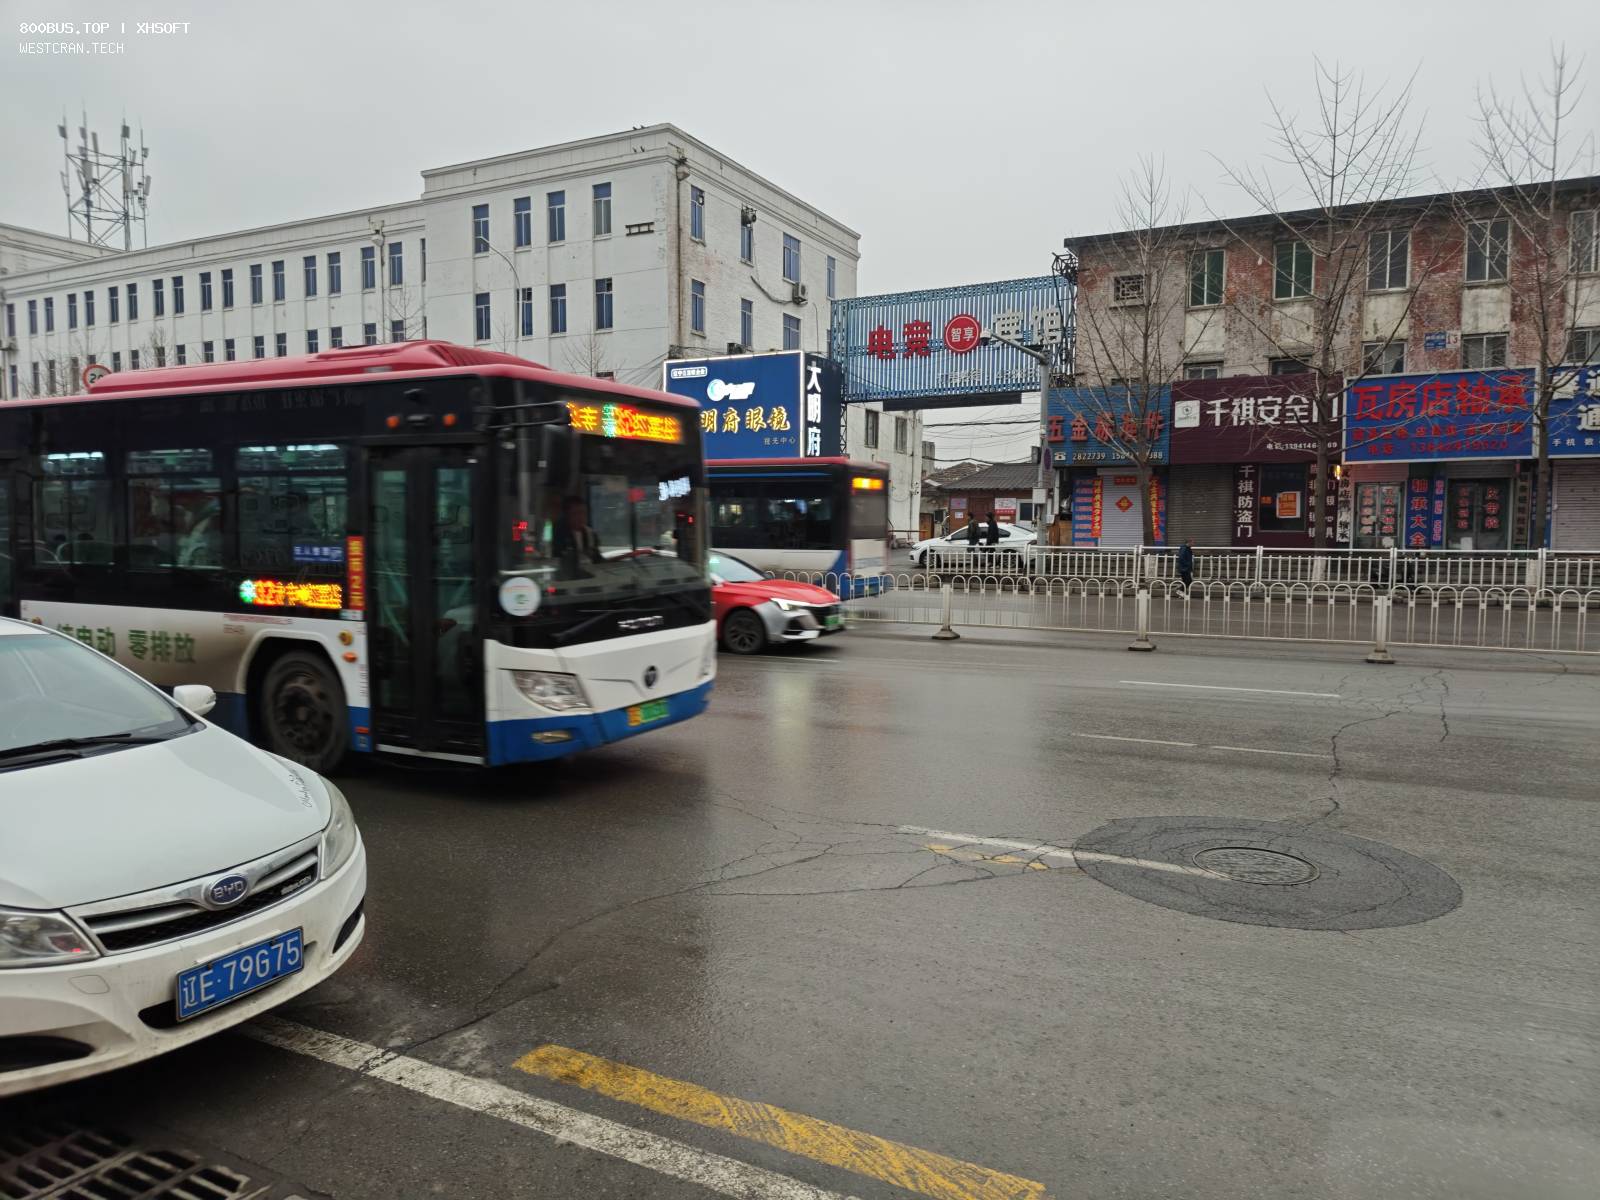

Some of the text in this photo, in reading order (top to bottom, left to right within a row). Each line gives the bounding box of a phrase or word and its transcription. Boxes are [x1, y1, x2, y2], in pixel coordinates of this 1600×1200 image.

[868, 319, 932, 360] 电竞
[950, 327, 974, 342] 智享
[806, 360, 822, 457] 大明府
[1206, 392, 1339, 426] 千祺安全门
[1352, 374, 1529, 421] 瓦房店轴承
[1237, 465, 1256, 538] 千祺防盗门
[1409, 478, 1429, 547] 轴承大全
[128, 629, 196, 664] 零排放
[213, 881, 244, 898] BYD
[182, 935, 300, 1010] 辽E·79G75
